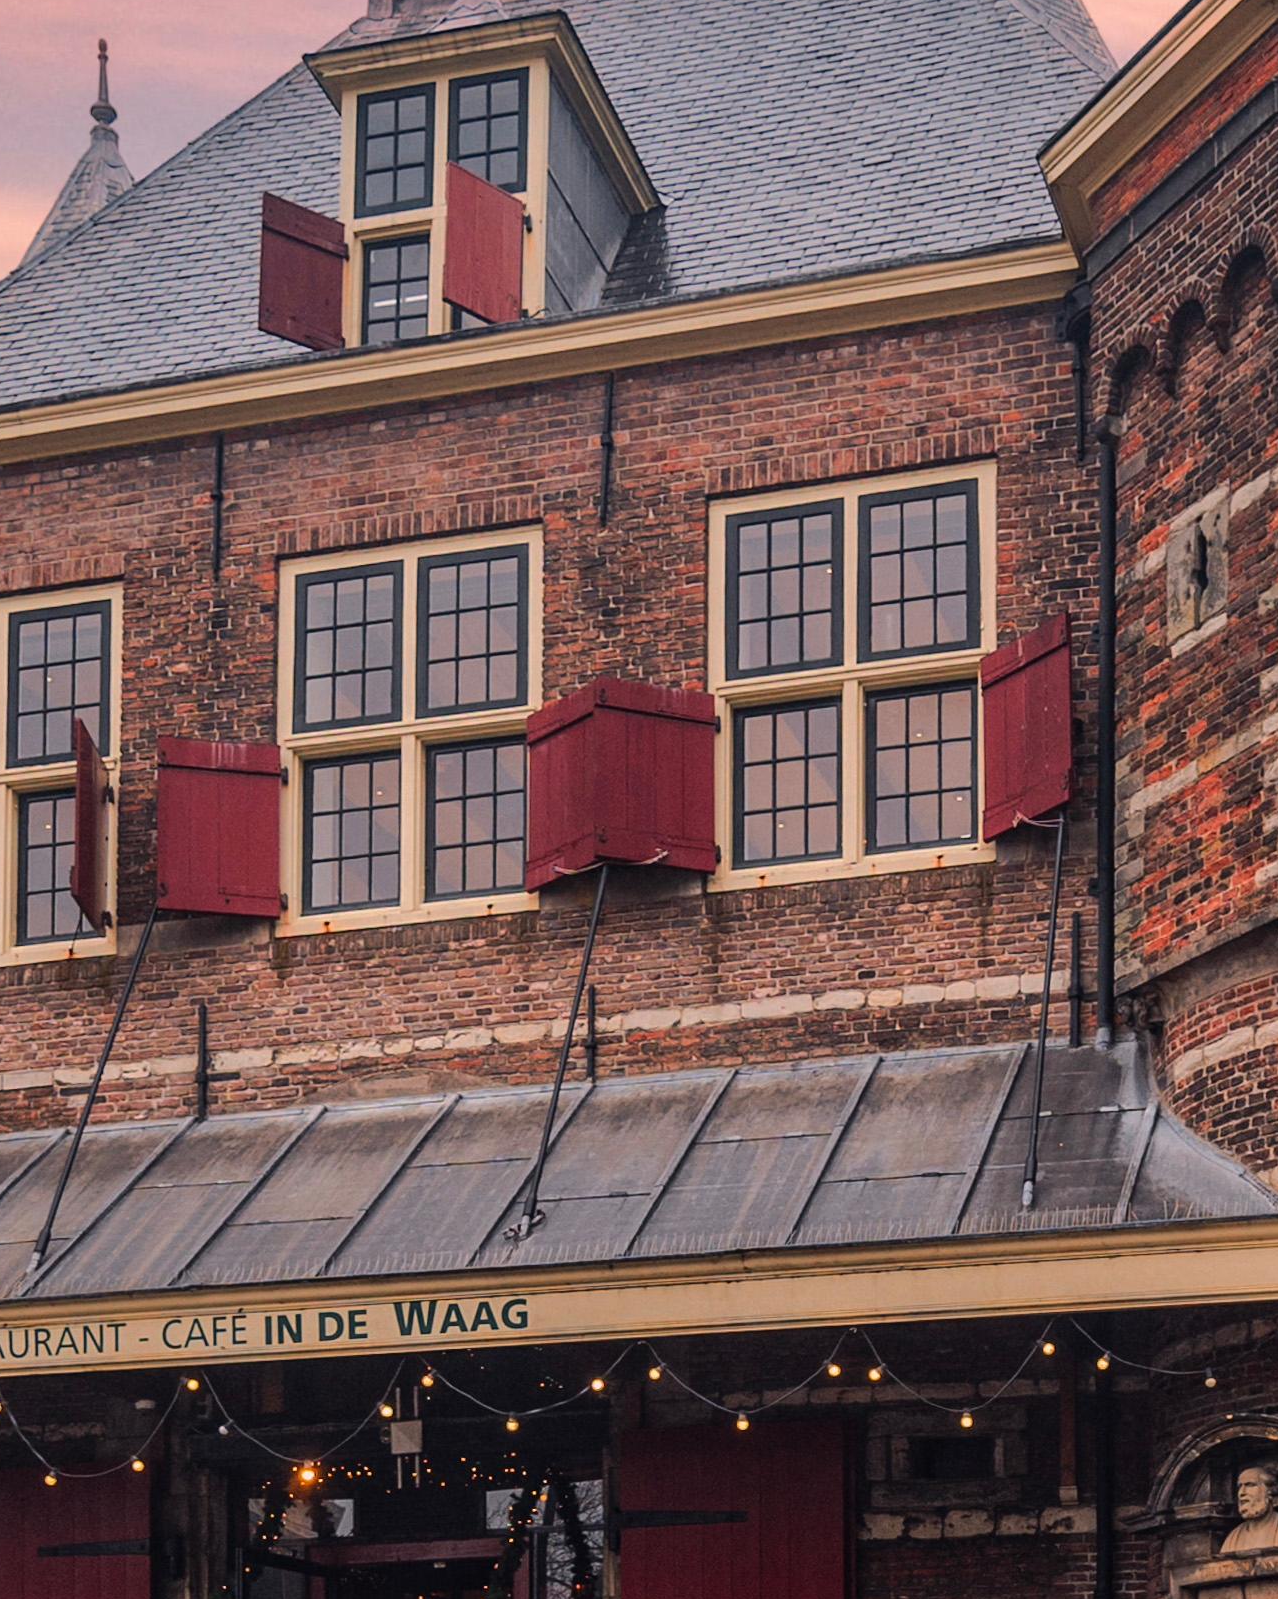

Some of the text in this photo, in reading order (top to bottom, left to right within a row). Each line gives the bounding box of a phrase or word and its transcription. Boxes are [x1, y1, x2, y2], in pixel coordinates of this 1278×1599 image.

[161, 1307, 248, 1350] CAFÉ
[264, 1313, 303, 1345] IN
[318, 1309, 369, 1342] DE
[393, 1298, 529, 1336] WAAG
